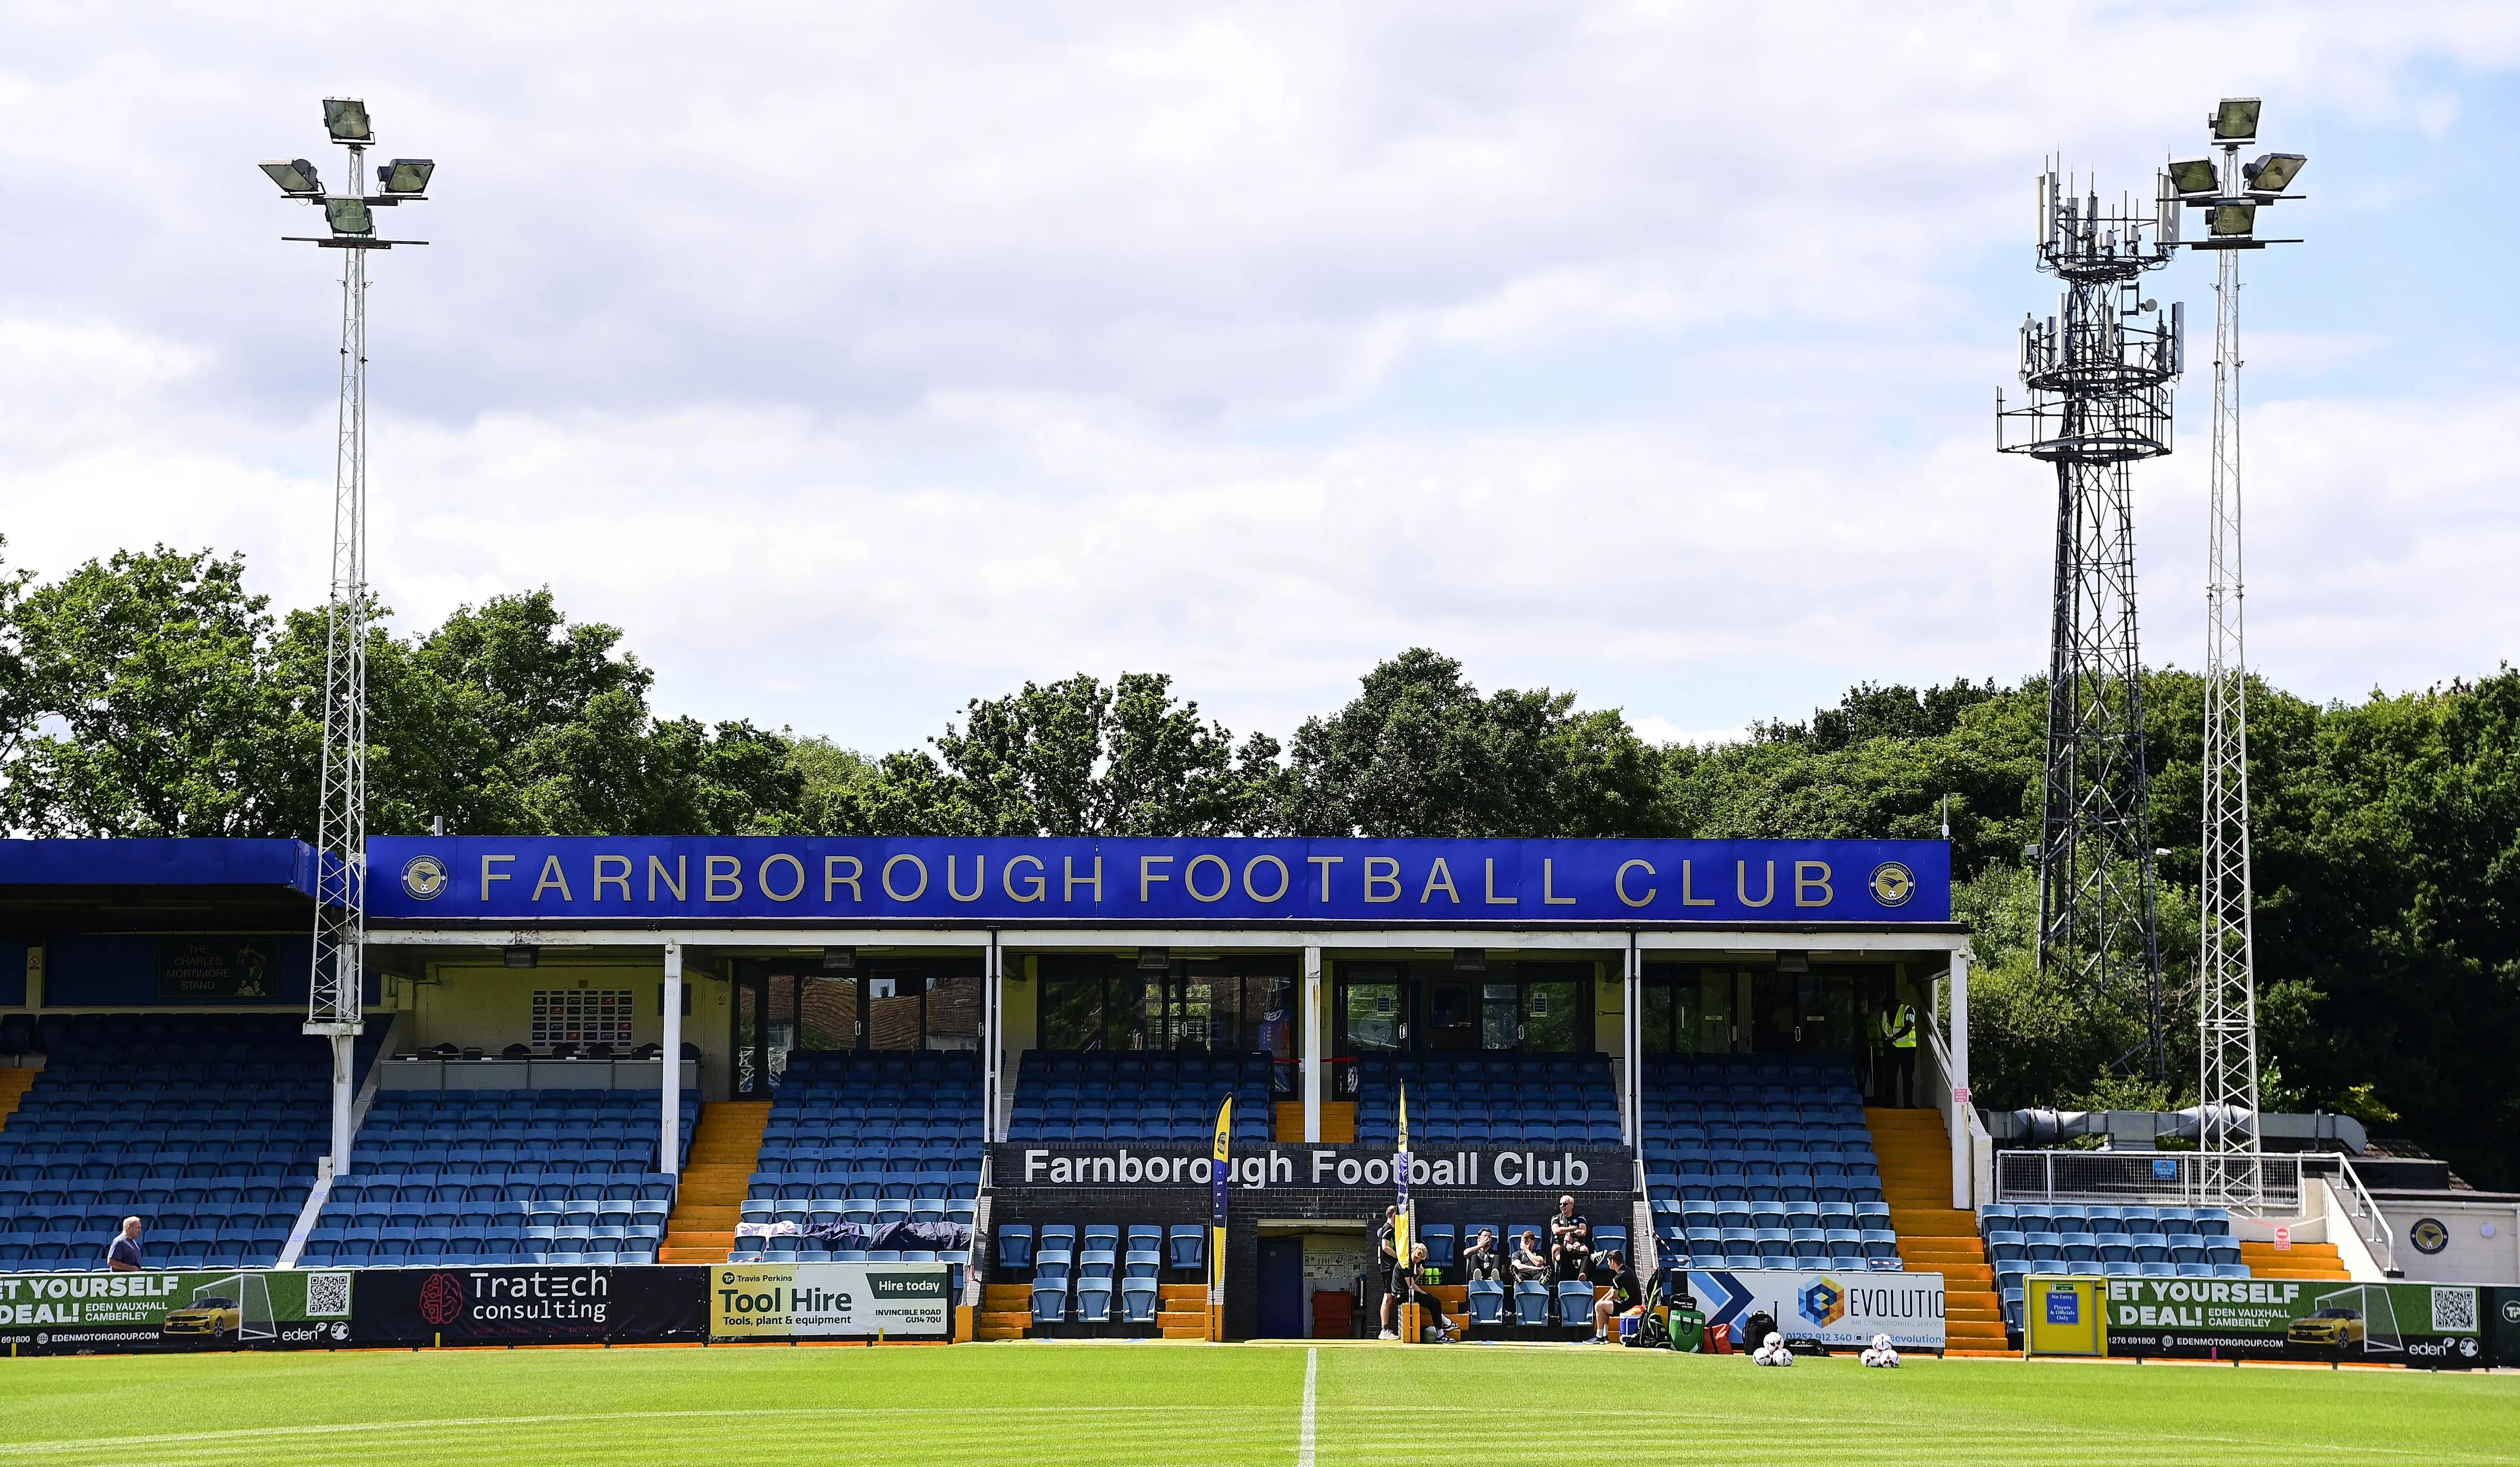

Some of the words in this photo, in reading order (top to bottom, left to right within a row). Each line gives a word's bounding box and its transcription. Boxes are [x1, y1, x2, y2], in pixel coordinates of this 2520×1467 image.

[407, 858, 442, 870] FARNBOROUGH
[1874, 864, 1909, 875] FARNBOROUGH
[482, 854, 1101, 902] FARNBOROUGH
[1141, 855, 1576, 904] FOOTBALL
[1616, 859, 1833, 907] CLUB
[1876, 896, 1897, 904] FOOTBALL
[189, 944, 208, 954] THE
[174, 957, 222, 966] CHARLES
[166, 968, 229, 978] MORTIMORE
[181, 981, 215, 990] STAND
[1026, 1150, 1292, 1189] Farnborough
[1313, 1151, 1477, 1185] Football
[1494, 1151, 1589, 1186] Club
[0, 1280, 21, 1300] T
[29, 1276, 179, 1299] YOURSELF
[879, 1280, 903, 1291] Hire
[906, 1280, 940, 1293] today
[2106, 1280, 2143, 1301] ET
[2150, 1281, 2299, 1304] YOURSELF
[718, 1287, 780, 1313] Tool
[791, 1287, 852, 1312] Hire
[1851, 1288, 1945, 1318] EVOLUTIO
[86, 1303, 114, 1312] EDEN
[116, 1302, 168, 1311] VAUXHALL
[473, 1300, 606, 1322] consulting
[0, 1303, 79, 1324] DEAL!
[85, 1312, 148, 1321] CAMBERLEY
[2120, 1306, 2202, 1326] DEAL!
[2208, 1308, 2235, 1317] EDEN
[2238, 1308, 2290, 1318] VAUXHALL
[723, 1316, 753, 1326] Tools,
[756, 1316, 782, 1326] plant
[785, 1316, 793, 1324] &
[795, 1315, 851, 1326] equipment
[2208, 1318, 2271, 1328] CAMBERLEY
[282, 1327, 318, 1341] eden
[569, 1325, 607, 1334] process
[52, 1332, 159, 1342] EDENMOTORGROUP.COM
[1815, 1333, 1830, 1342] 912
[1866, 1333, 1944, 1343] inevolution
[2177, 1338, 2283, 1348] EDENMOTORGROUP.COM
[2409, 1343, 2446, 1356] eden
